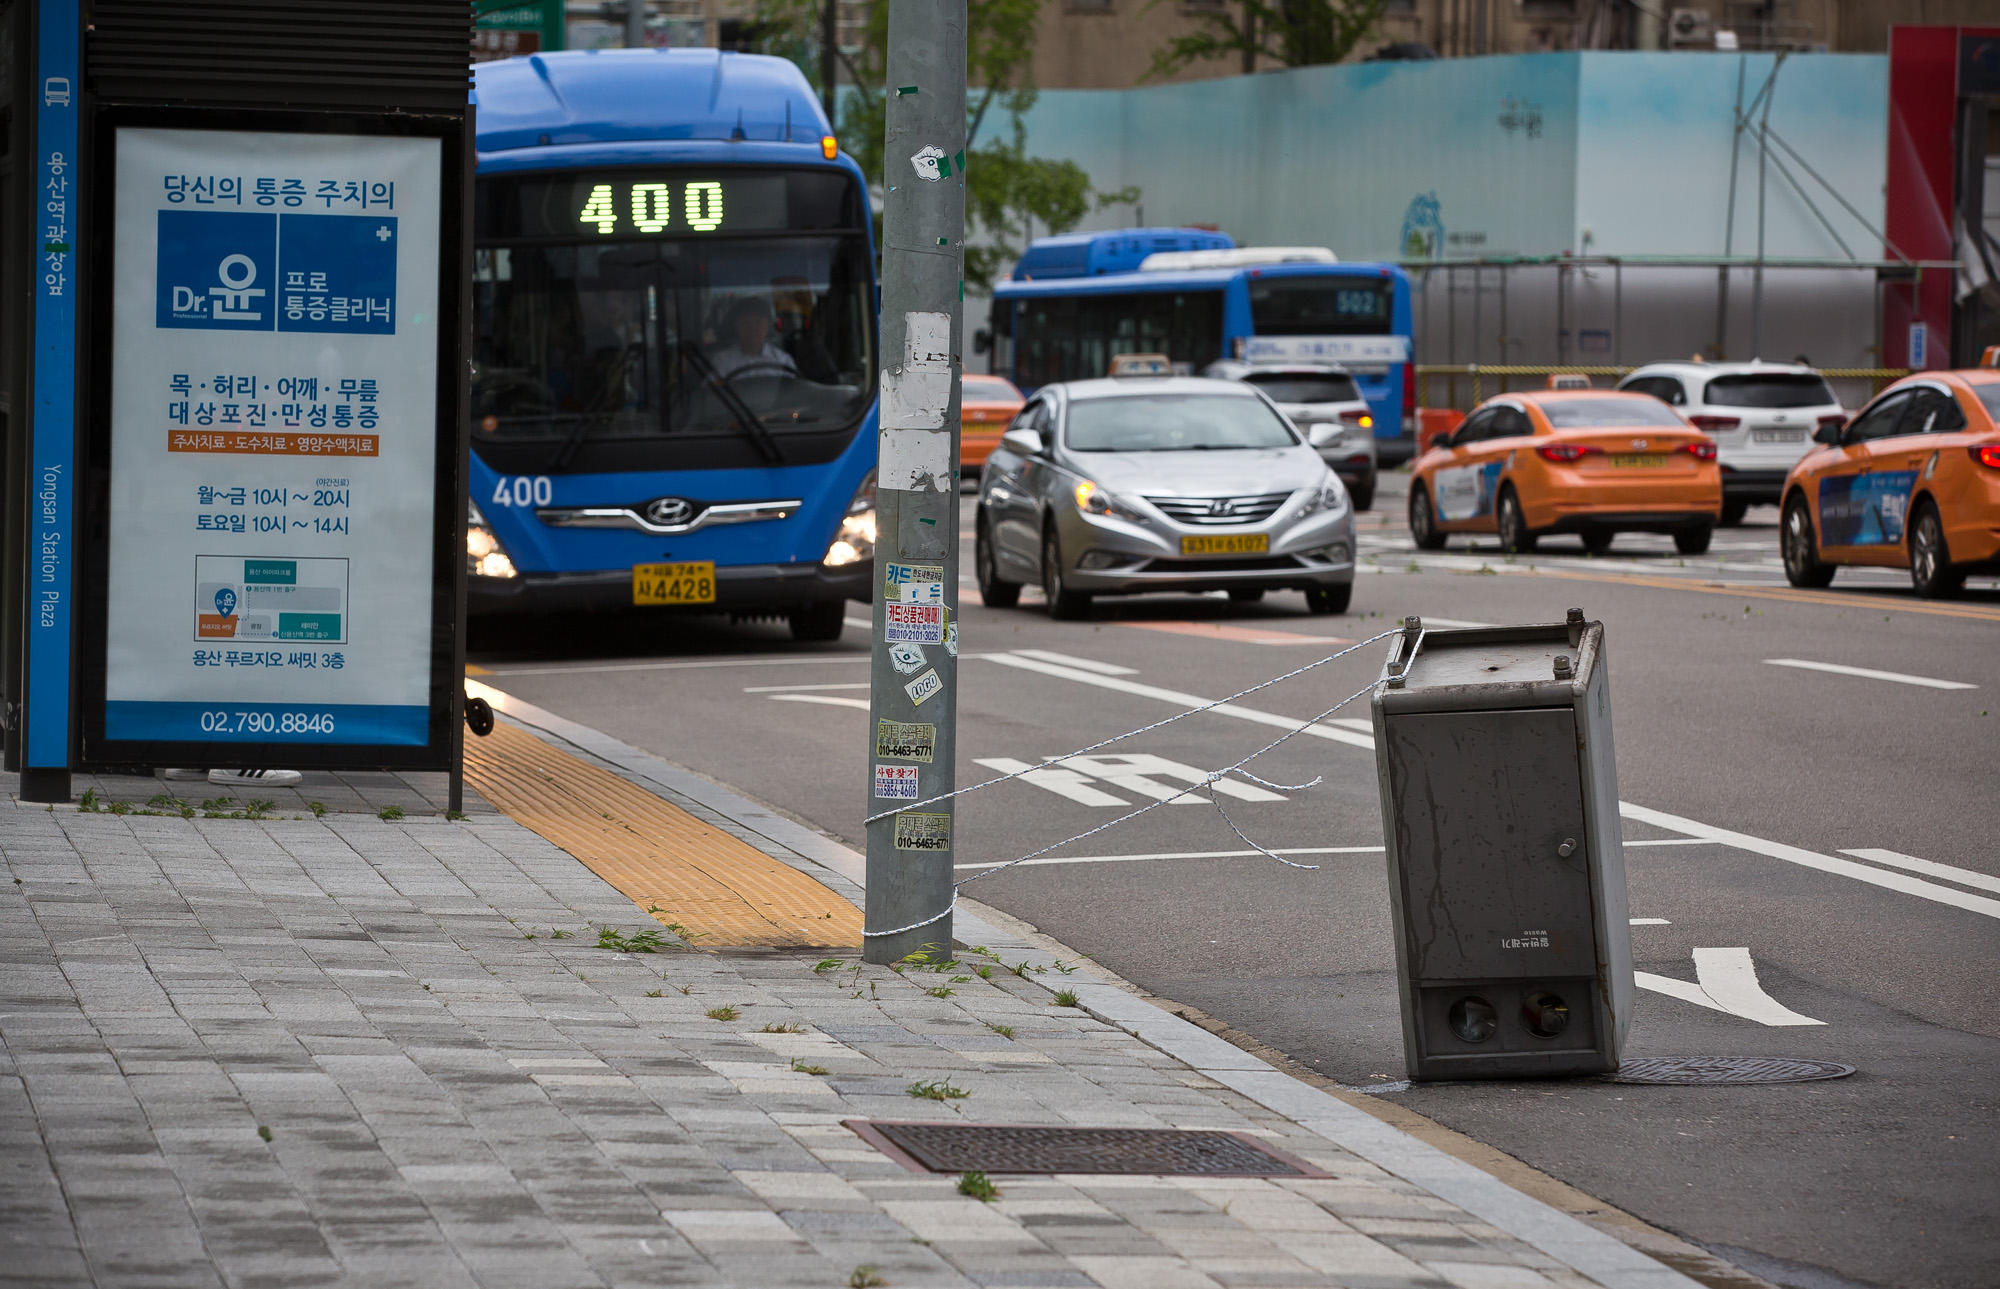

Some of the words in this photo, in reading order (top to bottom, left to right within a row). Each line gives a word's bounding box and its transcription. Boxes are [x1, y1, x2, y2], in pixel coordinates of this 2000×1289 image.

[164, 175, 242, 206] 당신의
[252, 177, 307, 207] 통증
[315, 180, 395, 210] 주치의
[579, 182, 724, 234] 400
[172, 285, 208, 313] Dr.
[208, 253, 266, 320] 윤
[284, 271, 329, 293] 프로
[284, 295, 390, 323] 통증클리닉
[39, 464, 62, 524] Yongsan
[252, 488, 287, 507] 10시
[313, 489, 350, 508] 20시
[492, 475, 553, 508] 400
[196, 514, 246, 533] 토요일
[252, 515, 287, 534] 10시
[313, 516, 349, 535] 14시
[42, 532, 61, 582] Station
[41, 591, 60, 628] Plaza
[192, 650, 222, 667] 용산
[224, 650, 284, 668] 푸르지오
[287, 652, 317, 669] 써밋
[321, 652, 345, 670] 3층
[200, 711, 335, 734] 02.790.8846
[878, 744, 932, 756] 010-6463-6771
[897, 836, 949, 849] 010-6463-6771
